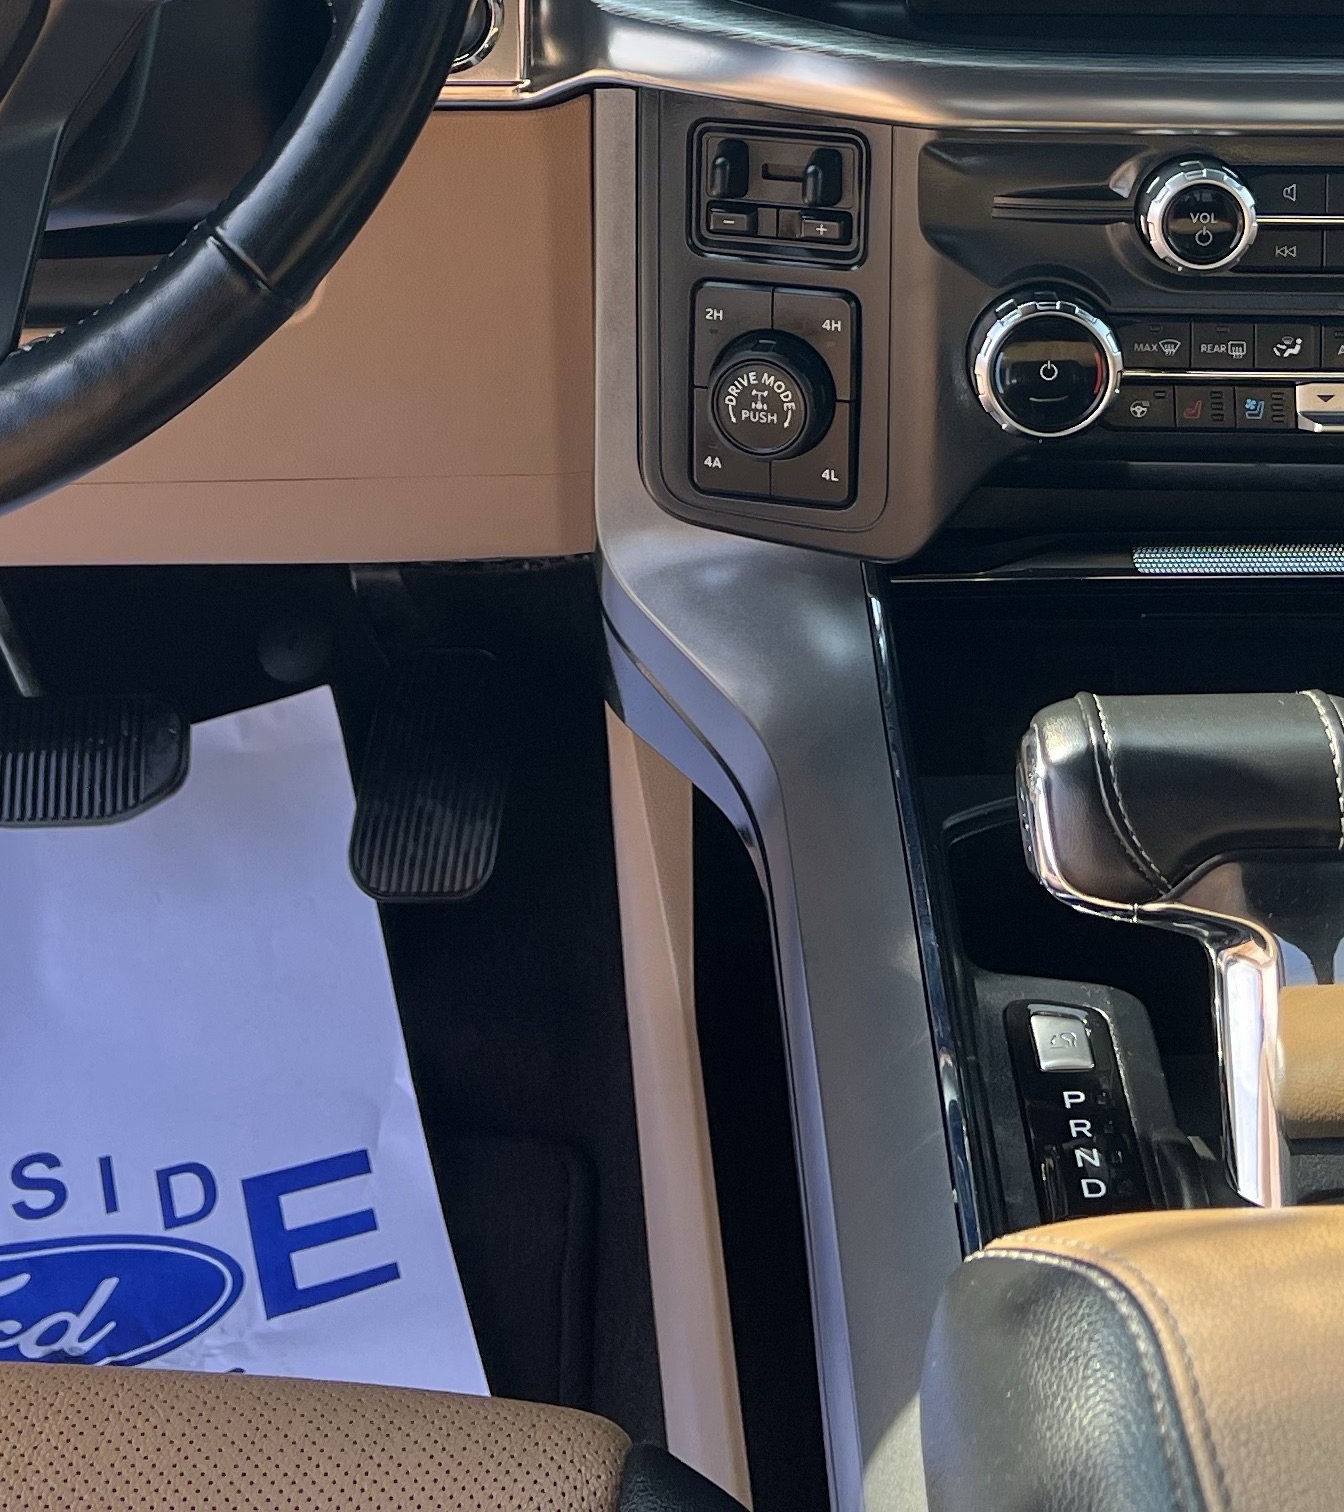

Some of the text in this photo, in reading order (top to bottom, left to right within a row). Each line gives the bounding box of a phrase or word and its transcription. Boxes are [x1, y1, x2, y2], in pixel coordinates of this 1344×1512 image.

[1189, 212, 1218, 224] VOL
[705, 308, 723, 320] 2H
[821, 319, 842, 332] 4H
[1134, 342, 1158, 353] MAX
[1200, 343, 1226, 354] REAR
[724, 371, 797, 412] DRIVE MODE
[741, 409, 777, 424] PUSH
[703, 456, 722, 469] 4A
[821, 469, 839, 481] 4L
[1063, 1091, 1086, 1109] P
[1069, 1119, 1093, 1138] R
[1074, 1147, 1101, 1168] N
[1080, 1178, 1107, 1199] D
